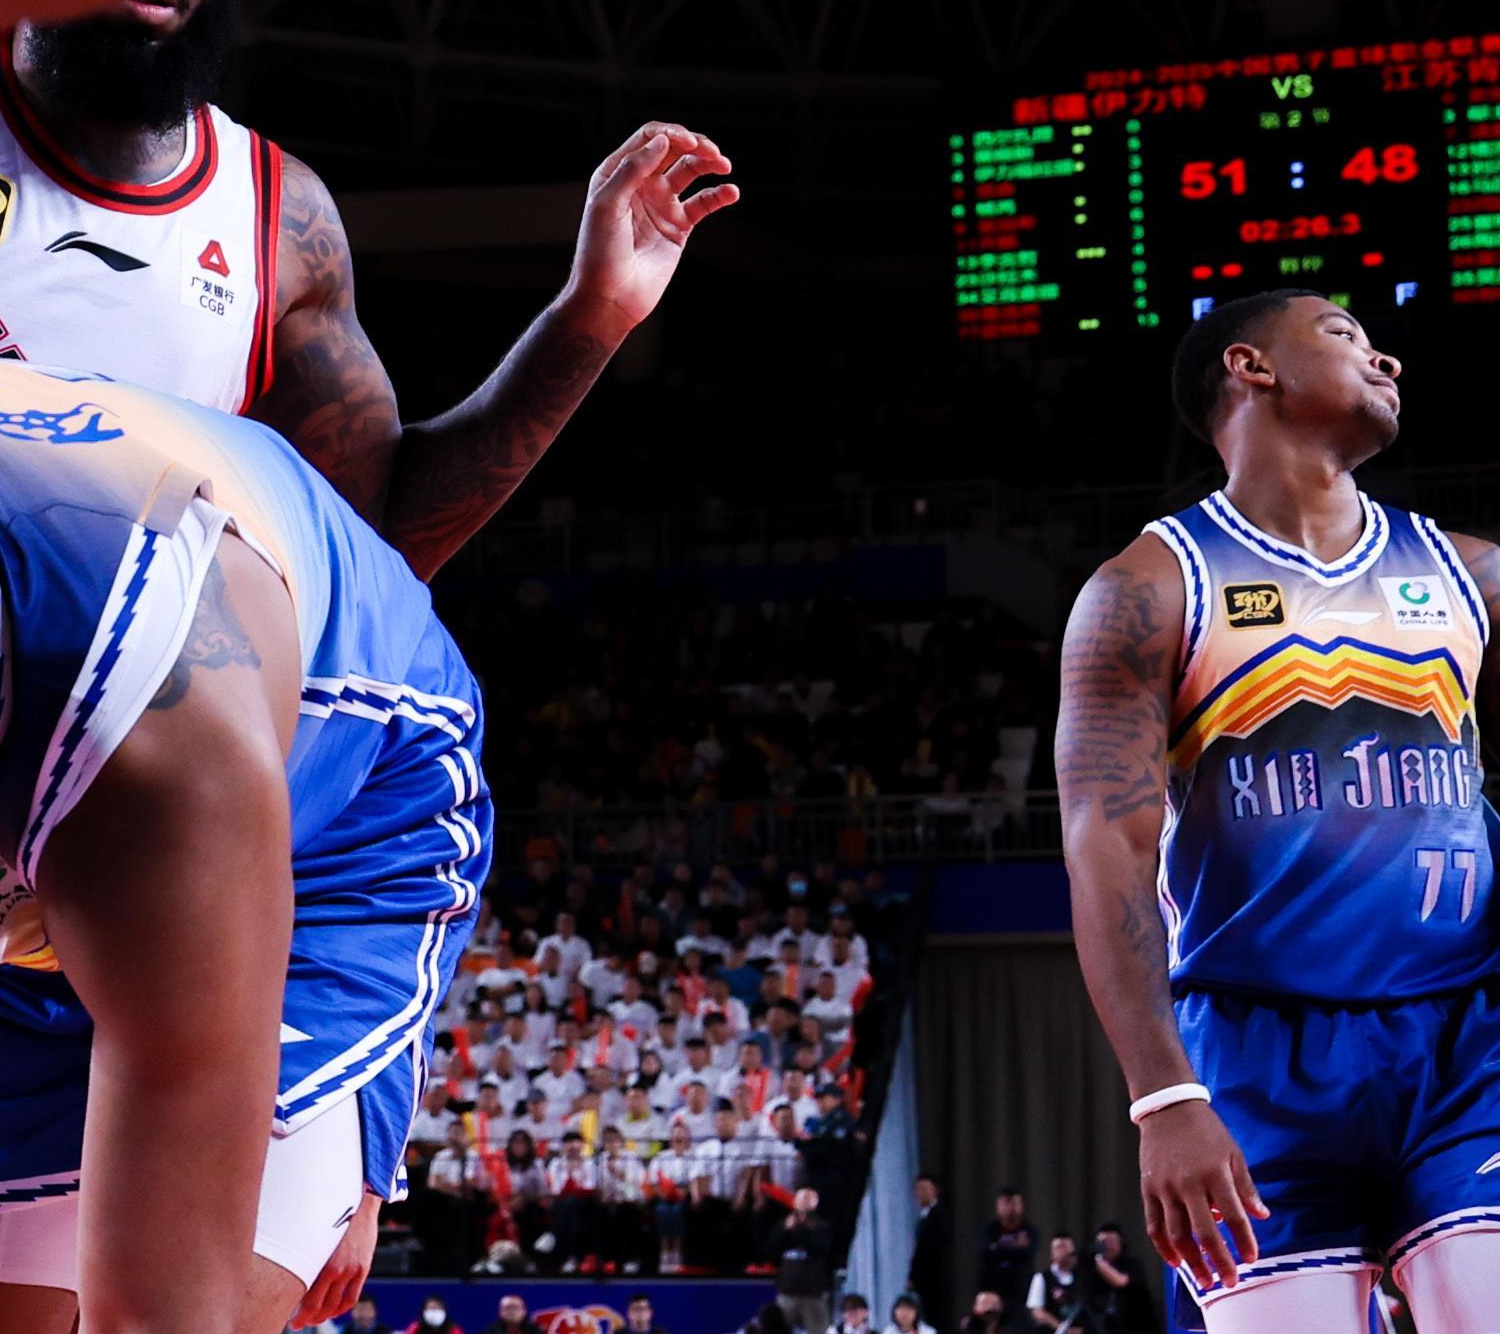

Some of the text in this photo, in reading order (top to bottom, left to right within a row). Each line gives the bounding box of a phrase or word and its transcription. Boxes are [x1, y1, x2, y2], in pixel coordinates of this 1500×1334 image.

[1271, 74, 1313, 99] VS
[1181, 158, 1247, 200] 51
[1341, 143, 1419, 184] 48
[1240, 212, 1361, 243] 02:26.3
[191, 276, 235, 304] 广发银行
[199, 295, 225, 315] CGB
[1397, 610, 1447, 618] 中国人寿
[1228, 731, 1477, 821] XIN JIANG
[1414, 849, 1476, 923] 77
